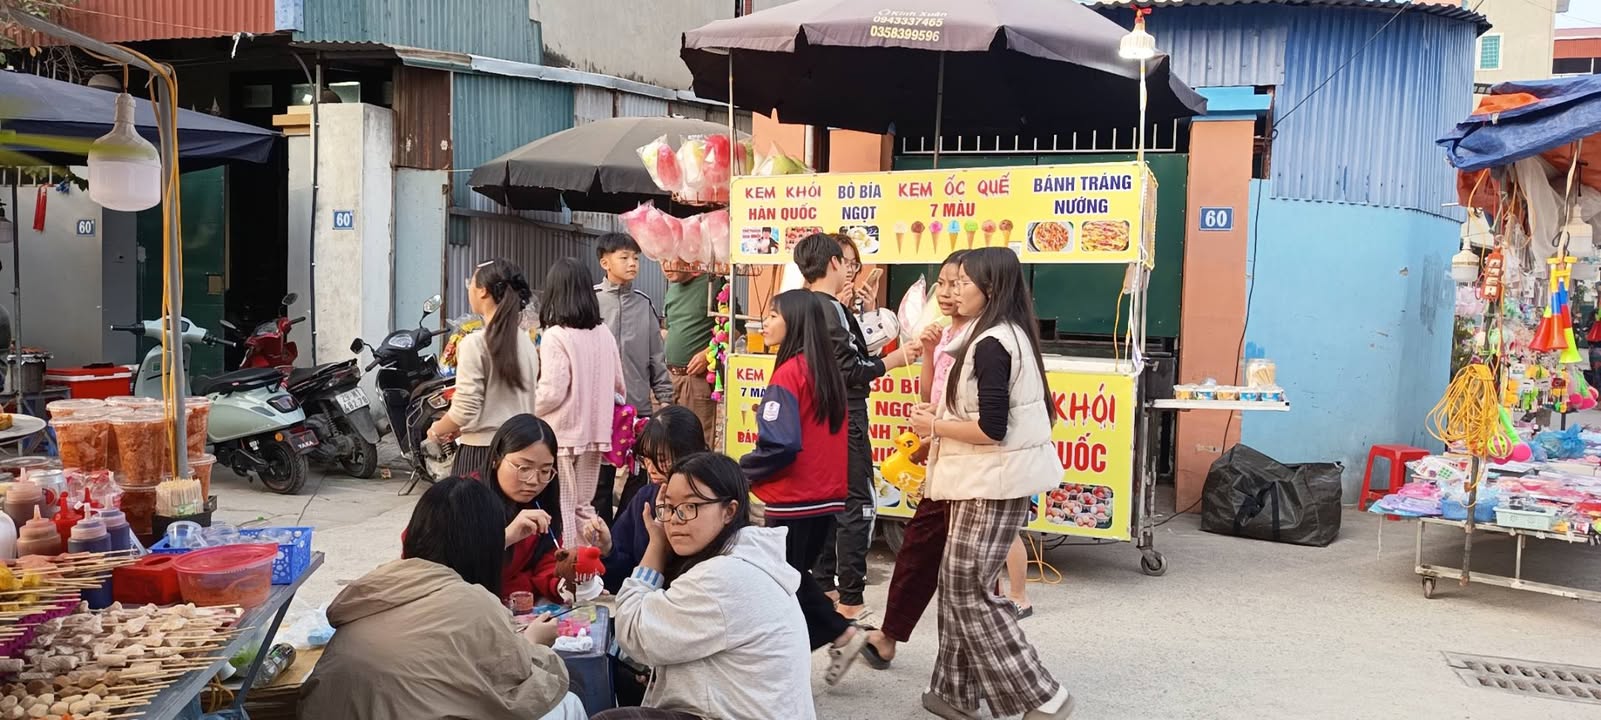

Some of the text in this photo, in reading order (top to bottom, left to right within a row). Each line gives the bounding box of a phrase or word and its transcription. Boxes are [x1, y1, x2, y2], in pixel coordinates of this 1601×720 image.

[872, 15, 945, 27] 0943337465
[870, 25, 940, 42] 0358399596
[745, 181, 822, 199] KEM KHÓI
[838, 181, 882, 199] BÒ BÍA
[898, 172, 1010, 198] KEM ỐC QUẾ
[1033, 172, 1132, 192] BÁNH TRÁNG
[748, 203, 817, 221] HÀN QUỐC
[842, 206, 877, 223] NGỌT
[930, 200, 976, 217] 7 MÀU
[1054, 197, 1108, 214] NƯỚNG
[1205, 210, 1228, 227] 60
[736, 368, 764, 381] KEM
[740, 387, 747, 397] 7
[901, 376, 920, 394] BÍ
[875, 400, 914, 421] NGỌ
[1052, 383, 1115, 424] KHÓI
[1057, 432, 1107, 473] UỐC
